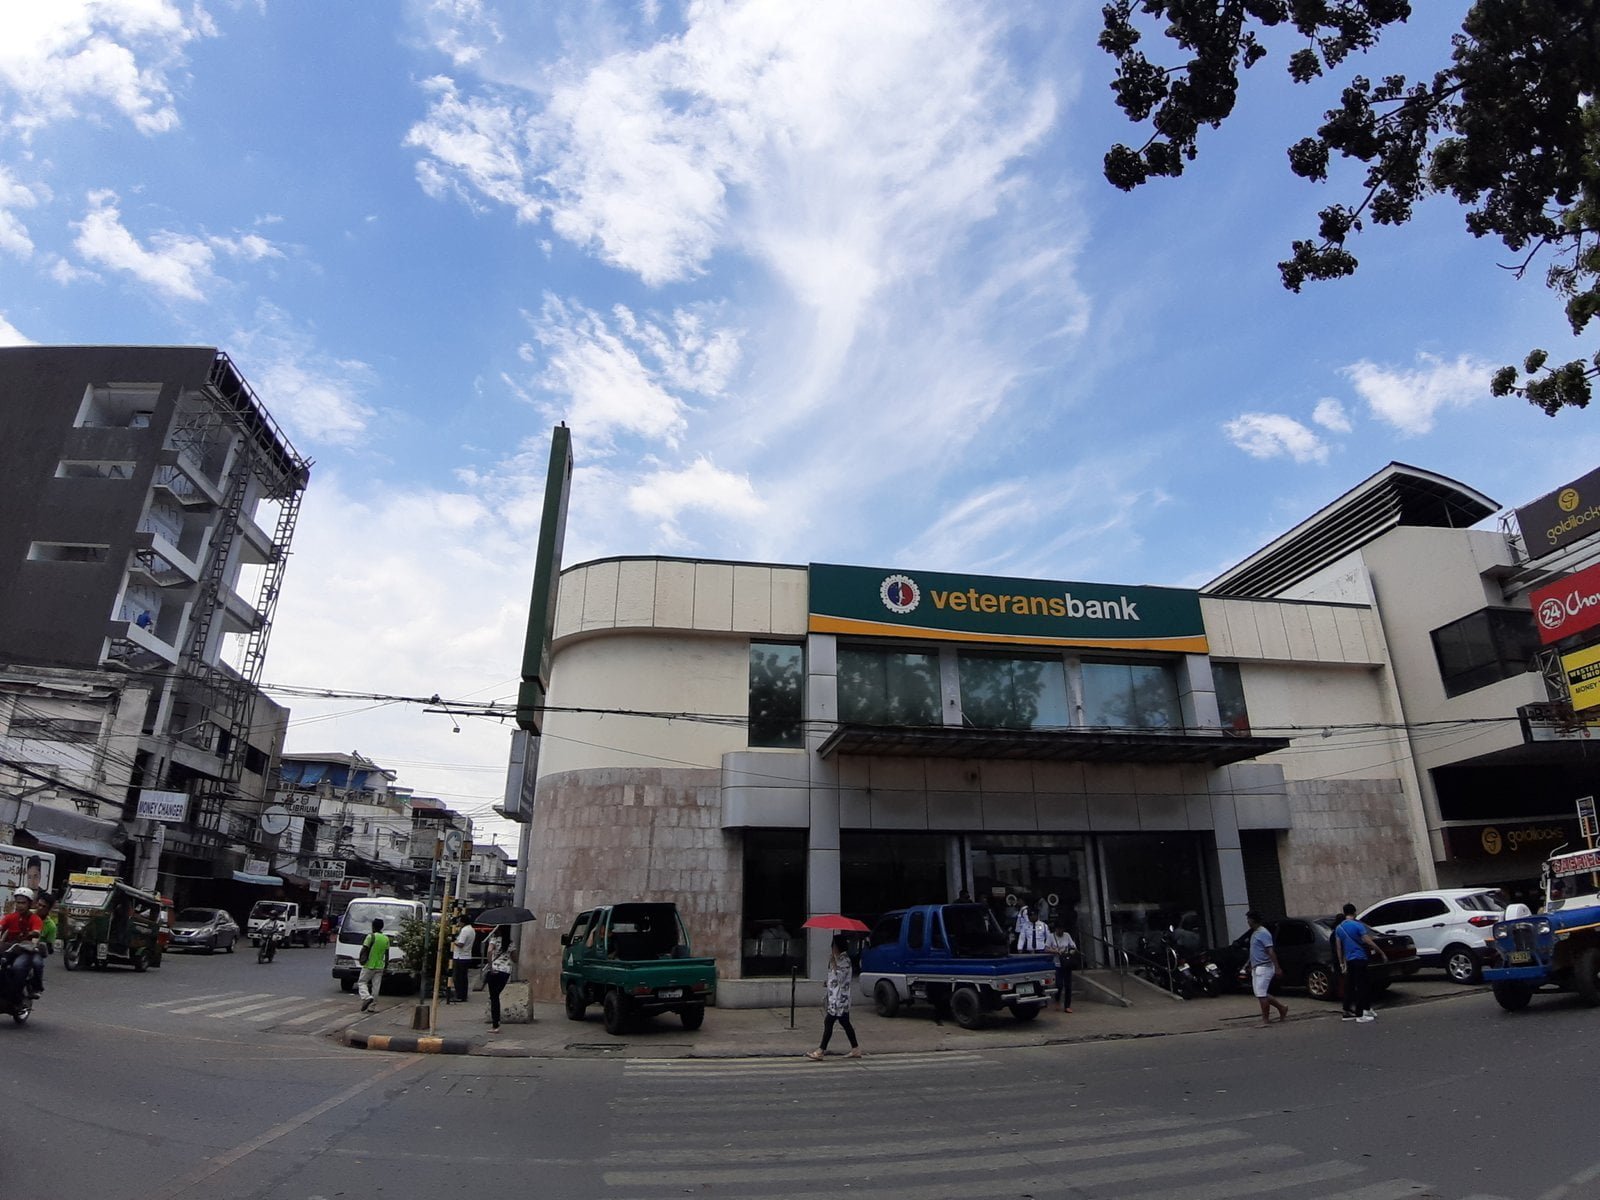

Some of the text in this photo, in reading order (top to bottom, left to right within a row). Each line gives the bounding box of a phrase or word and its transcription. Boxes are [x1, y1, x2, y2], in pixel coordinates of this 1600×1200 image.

[931, 588, 1140, 620] veteransbank
[1542, 604, 1560, 624] 24
[1576, 682, 1597, 693] MONEY
[139, 801, 183, 816] MONEY CHANGER
